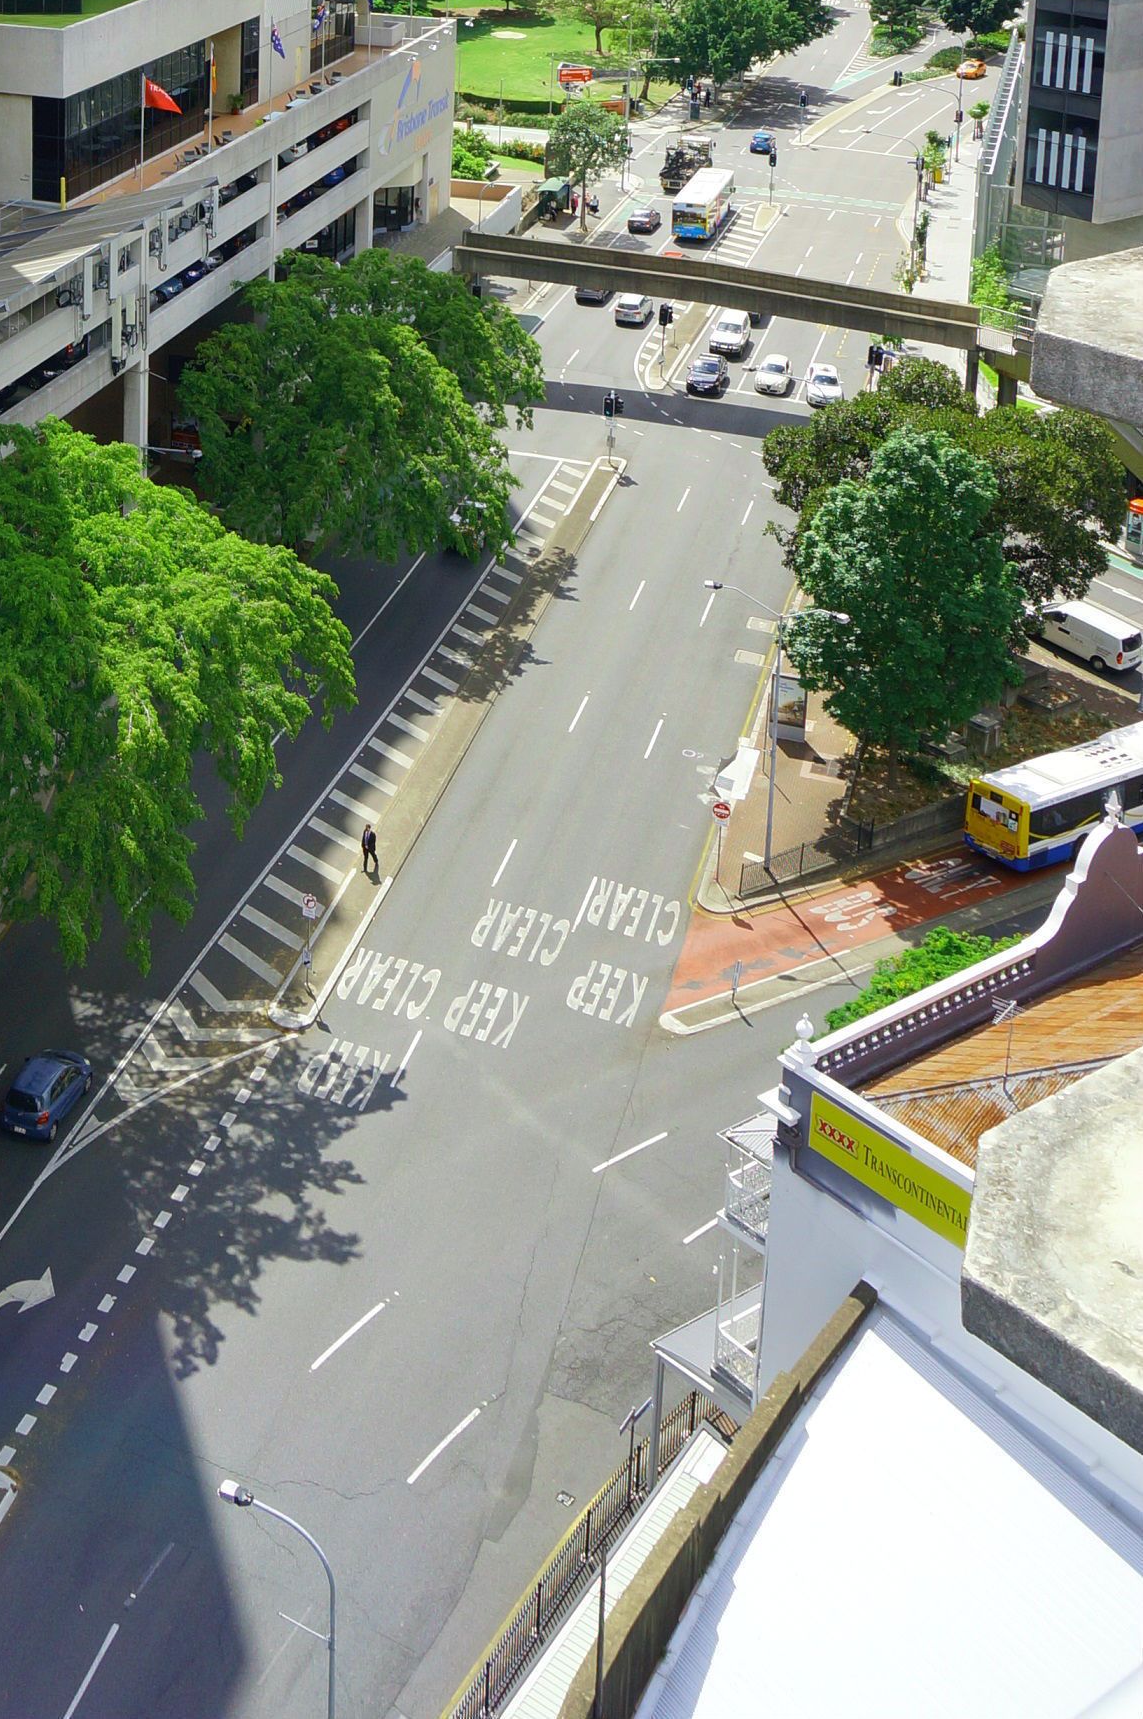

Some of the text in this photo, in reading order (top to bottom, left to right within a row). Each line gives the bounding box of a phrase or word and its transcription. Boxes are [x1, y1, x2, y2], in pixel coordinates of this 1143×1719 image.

[470, 898, 571, 966] CLEAR
[586, 877, 681, 946] CLEAR
[336, 947, 442, 1020] CLEAR
[443, 980, 530, 1049] KEEP
[566, 960, 649, 1028] KEEP
[298, 1038, 391, 1111] KEEP
[819, 1118, 856, 1154] XXXX
